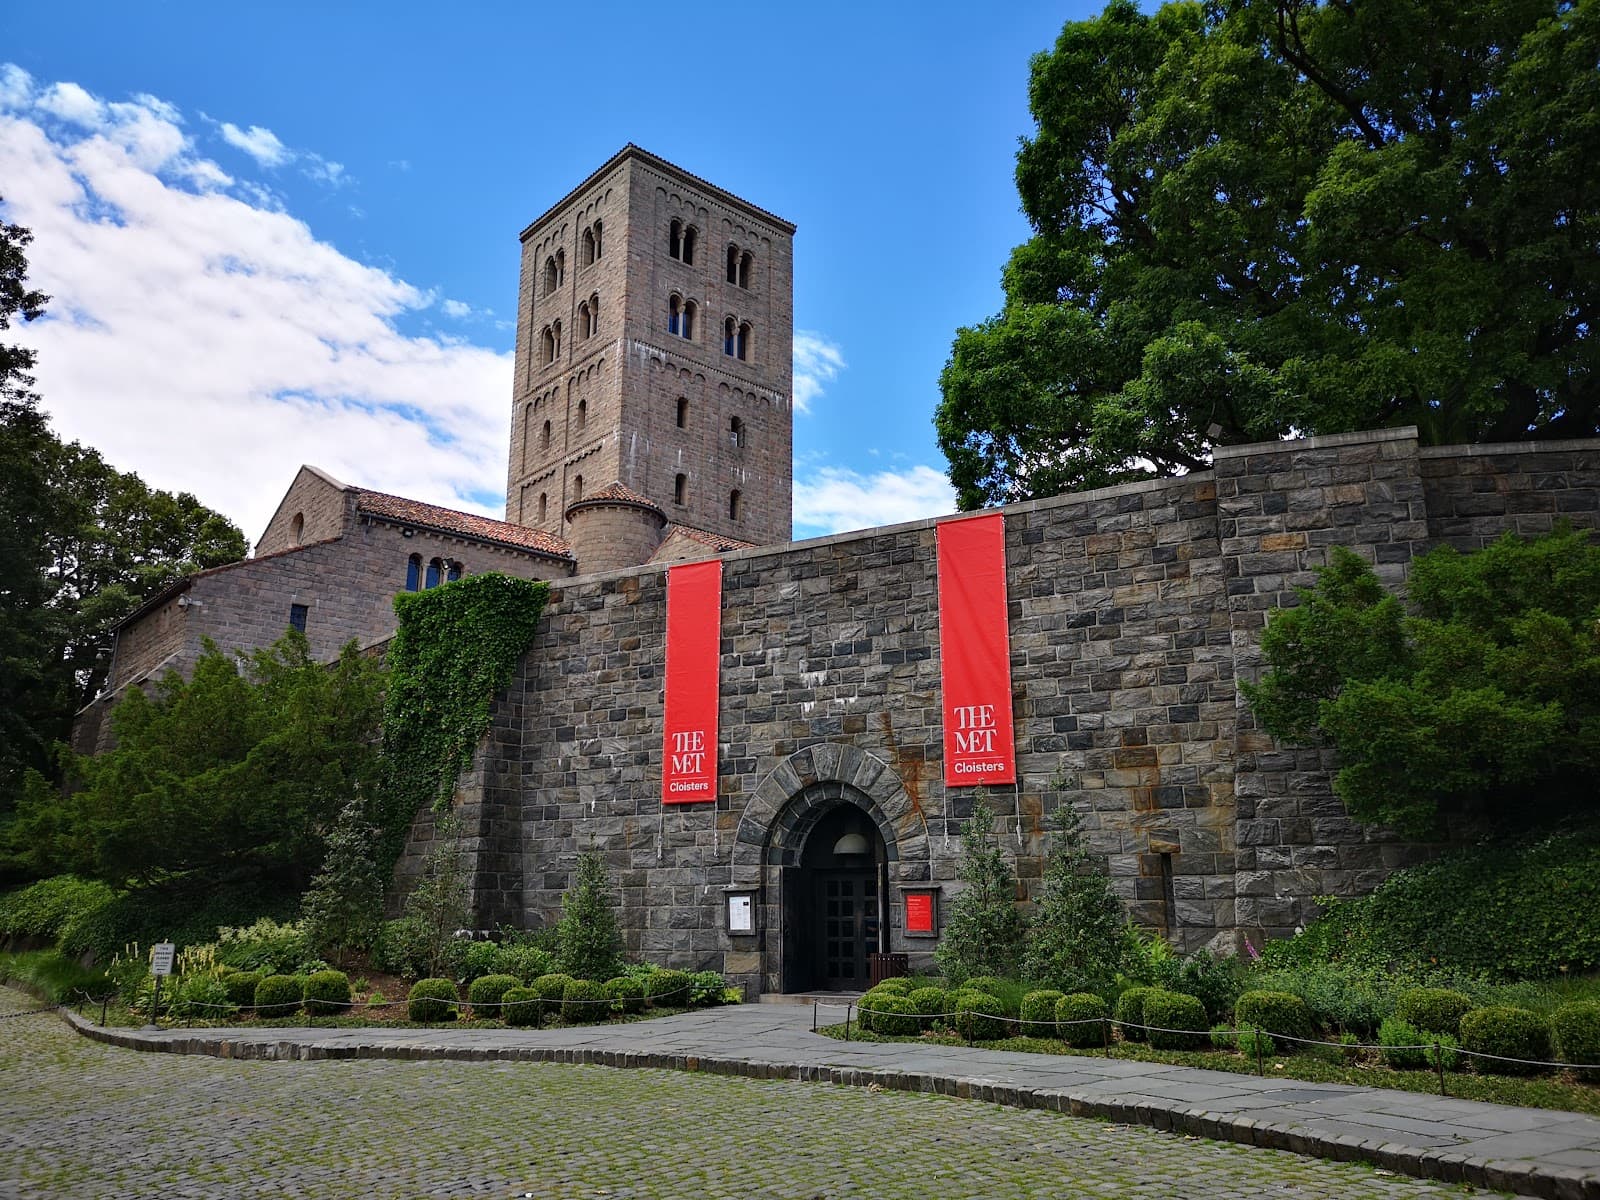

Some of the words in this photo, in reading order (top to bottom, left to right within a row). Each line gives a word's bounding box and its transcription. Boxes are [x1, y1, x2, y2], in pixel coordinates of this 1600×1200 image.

[953, 704, 996, 730] THE
[671, 730, 705, 753] THE
[953, 729, 998, 754] MET
[671, 752, 706, 775] MET
[954, 762, 1005, 774] Cloisters
[670, 782, 709, 792] Cloisters
